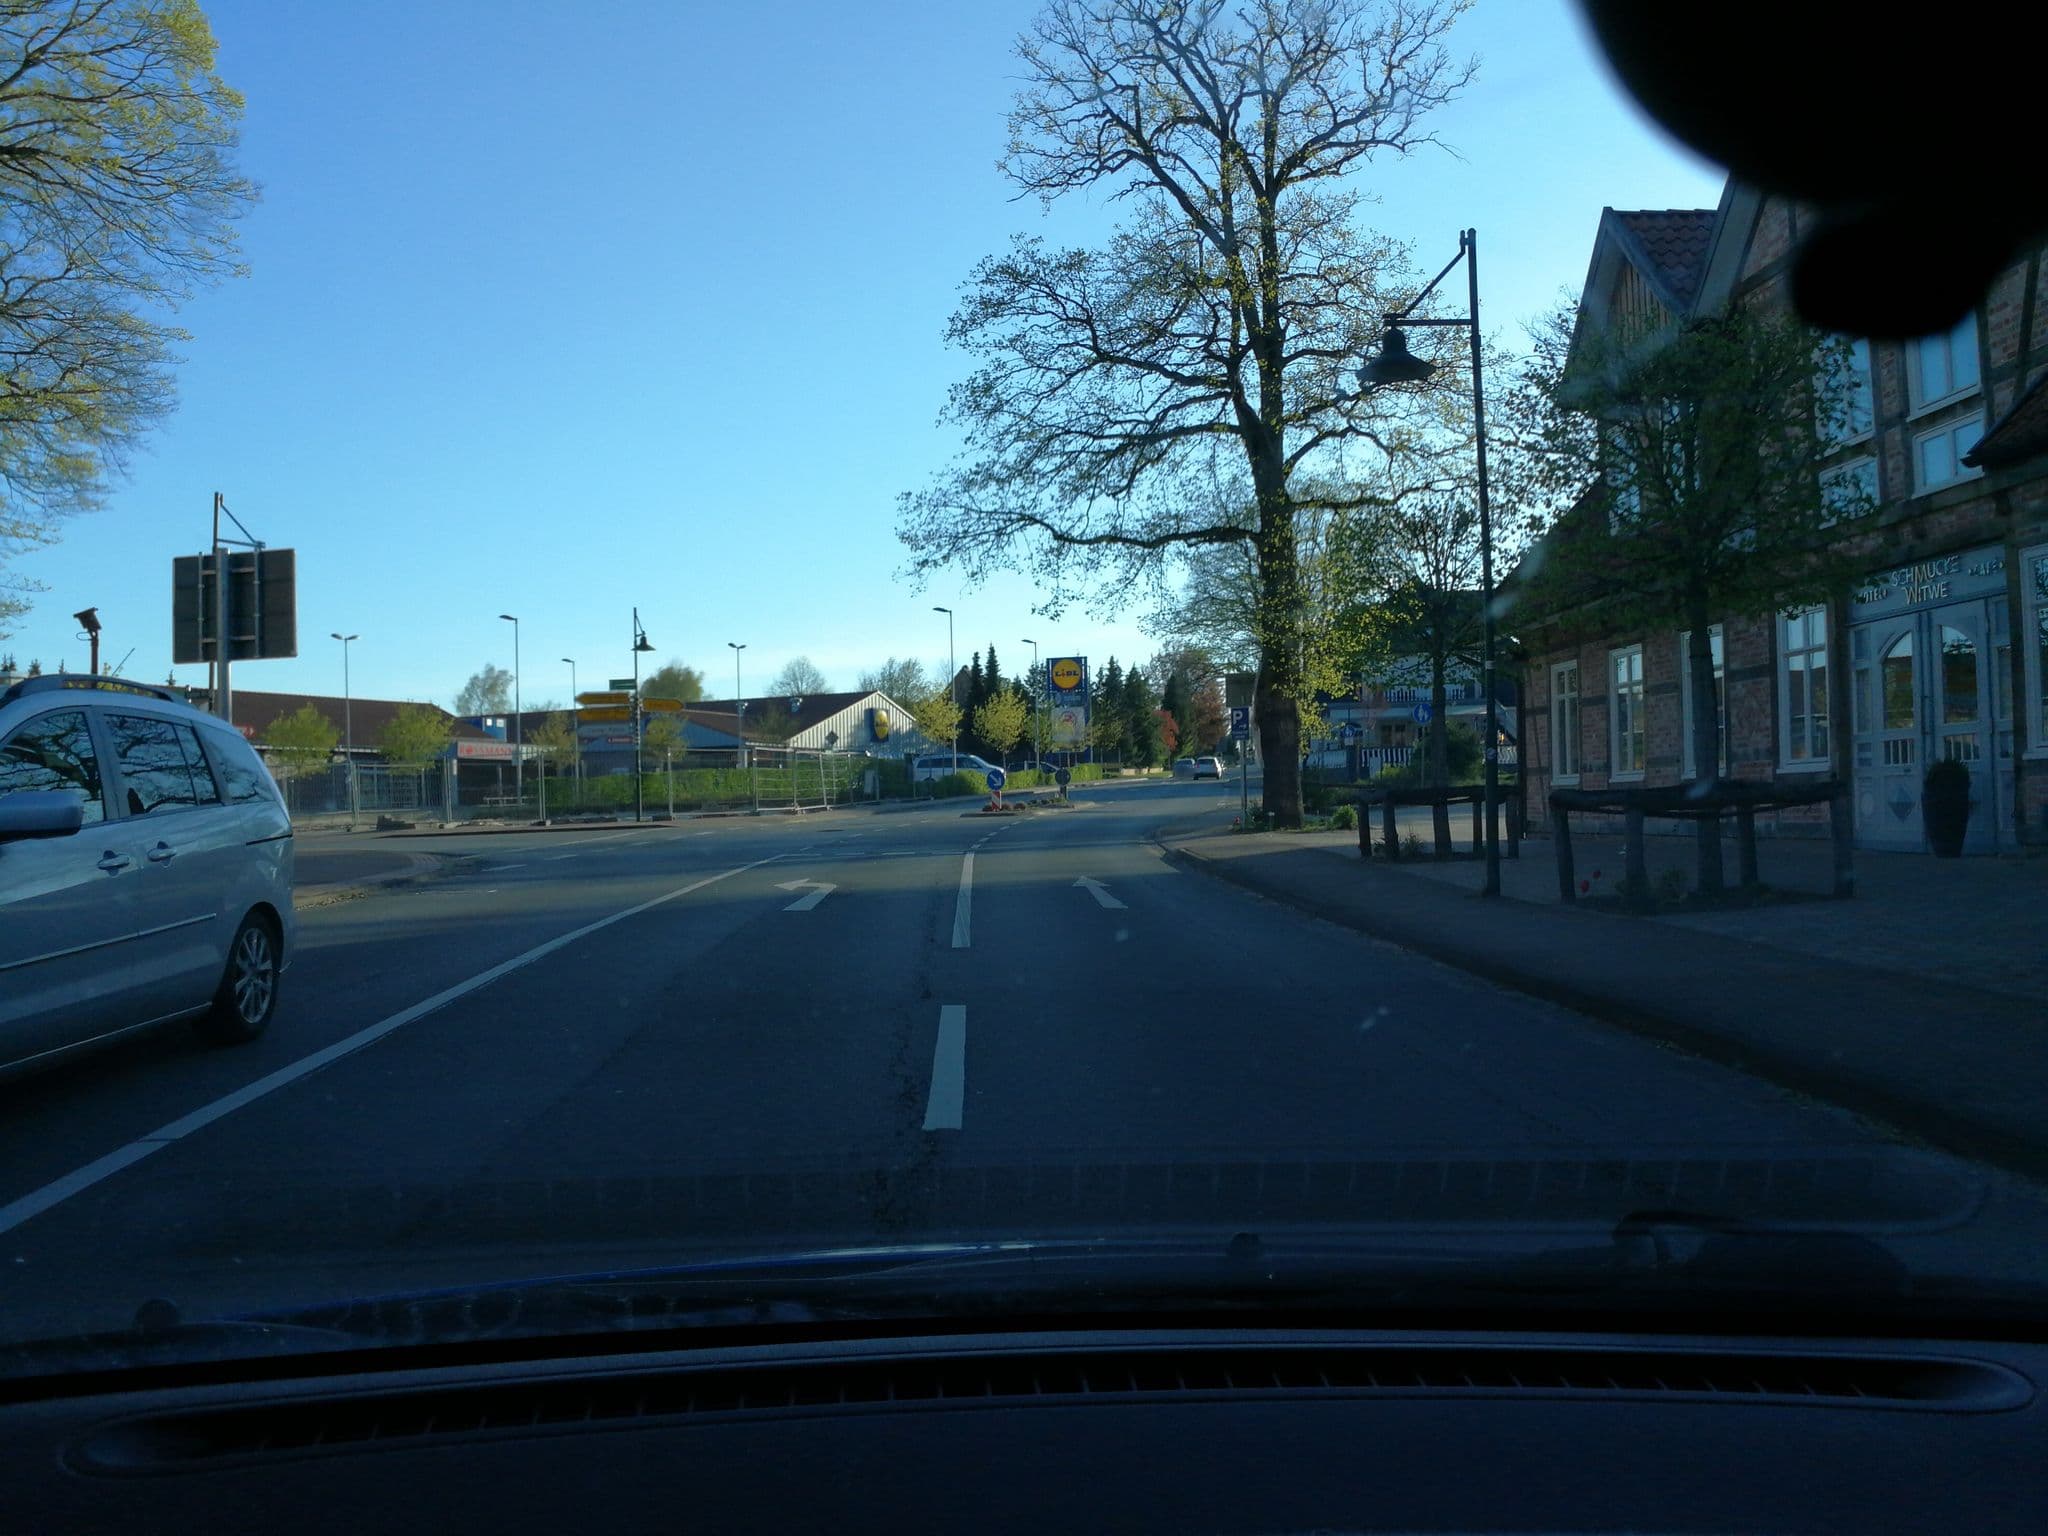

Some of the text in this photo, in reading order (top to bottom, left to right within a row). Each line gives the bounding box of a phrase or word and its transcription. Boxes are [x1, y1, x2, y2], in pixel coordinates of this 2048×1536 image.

[1891, 554, 1959, 587] SCHMUCKE
[1902, 580, 1949, 605] WITWE
[1233, 710, 1243, 725] P
